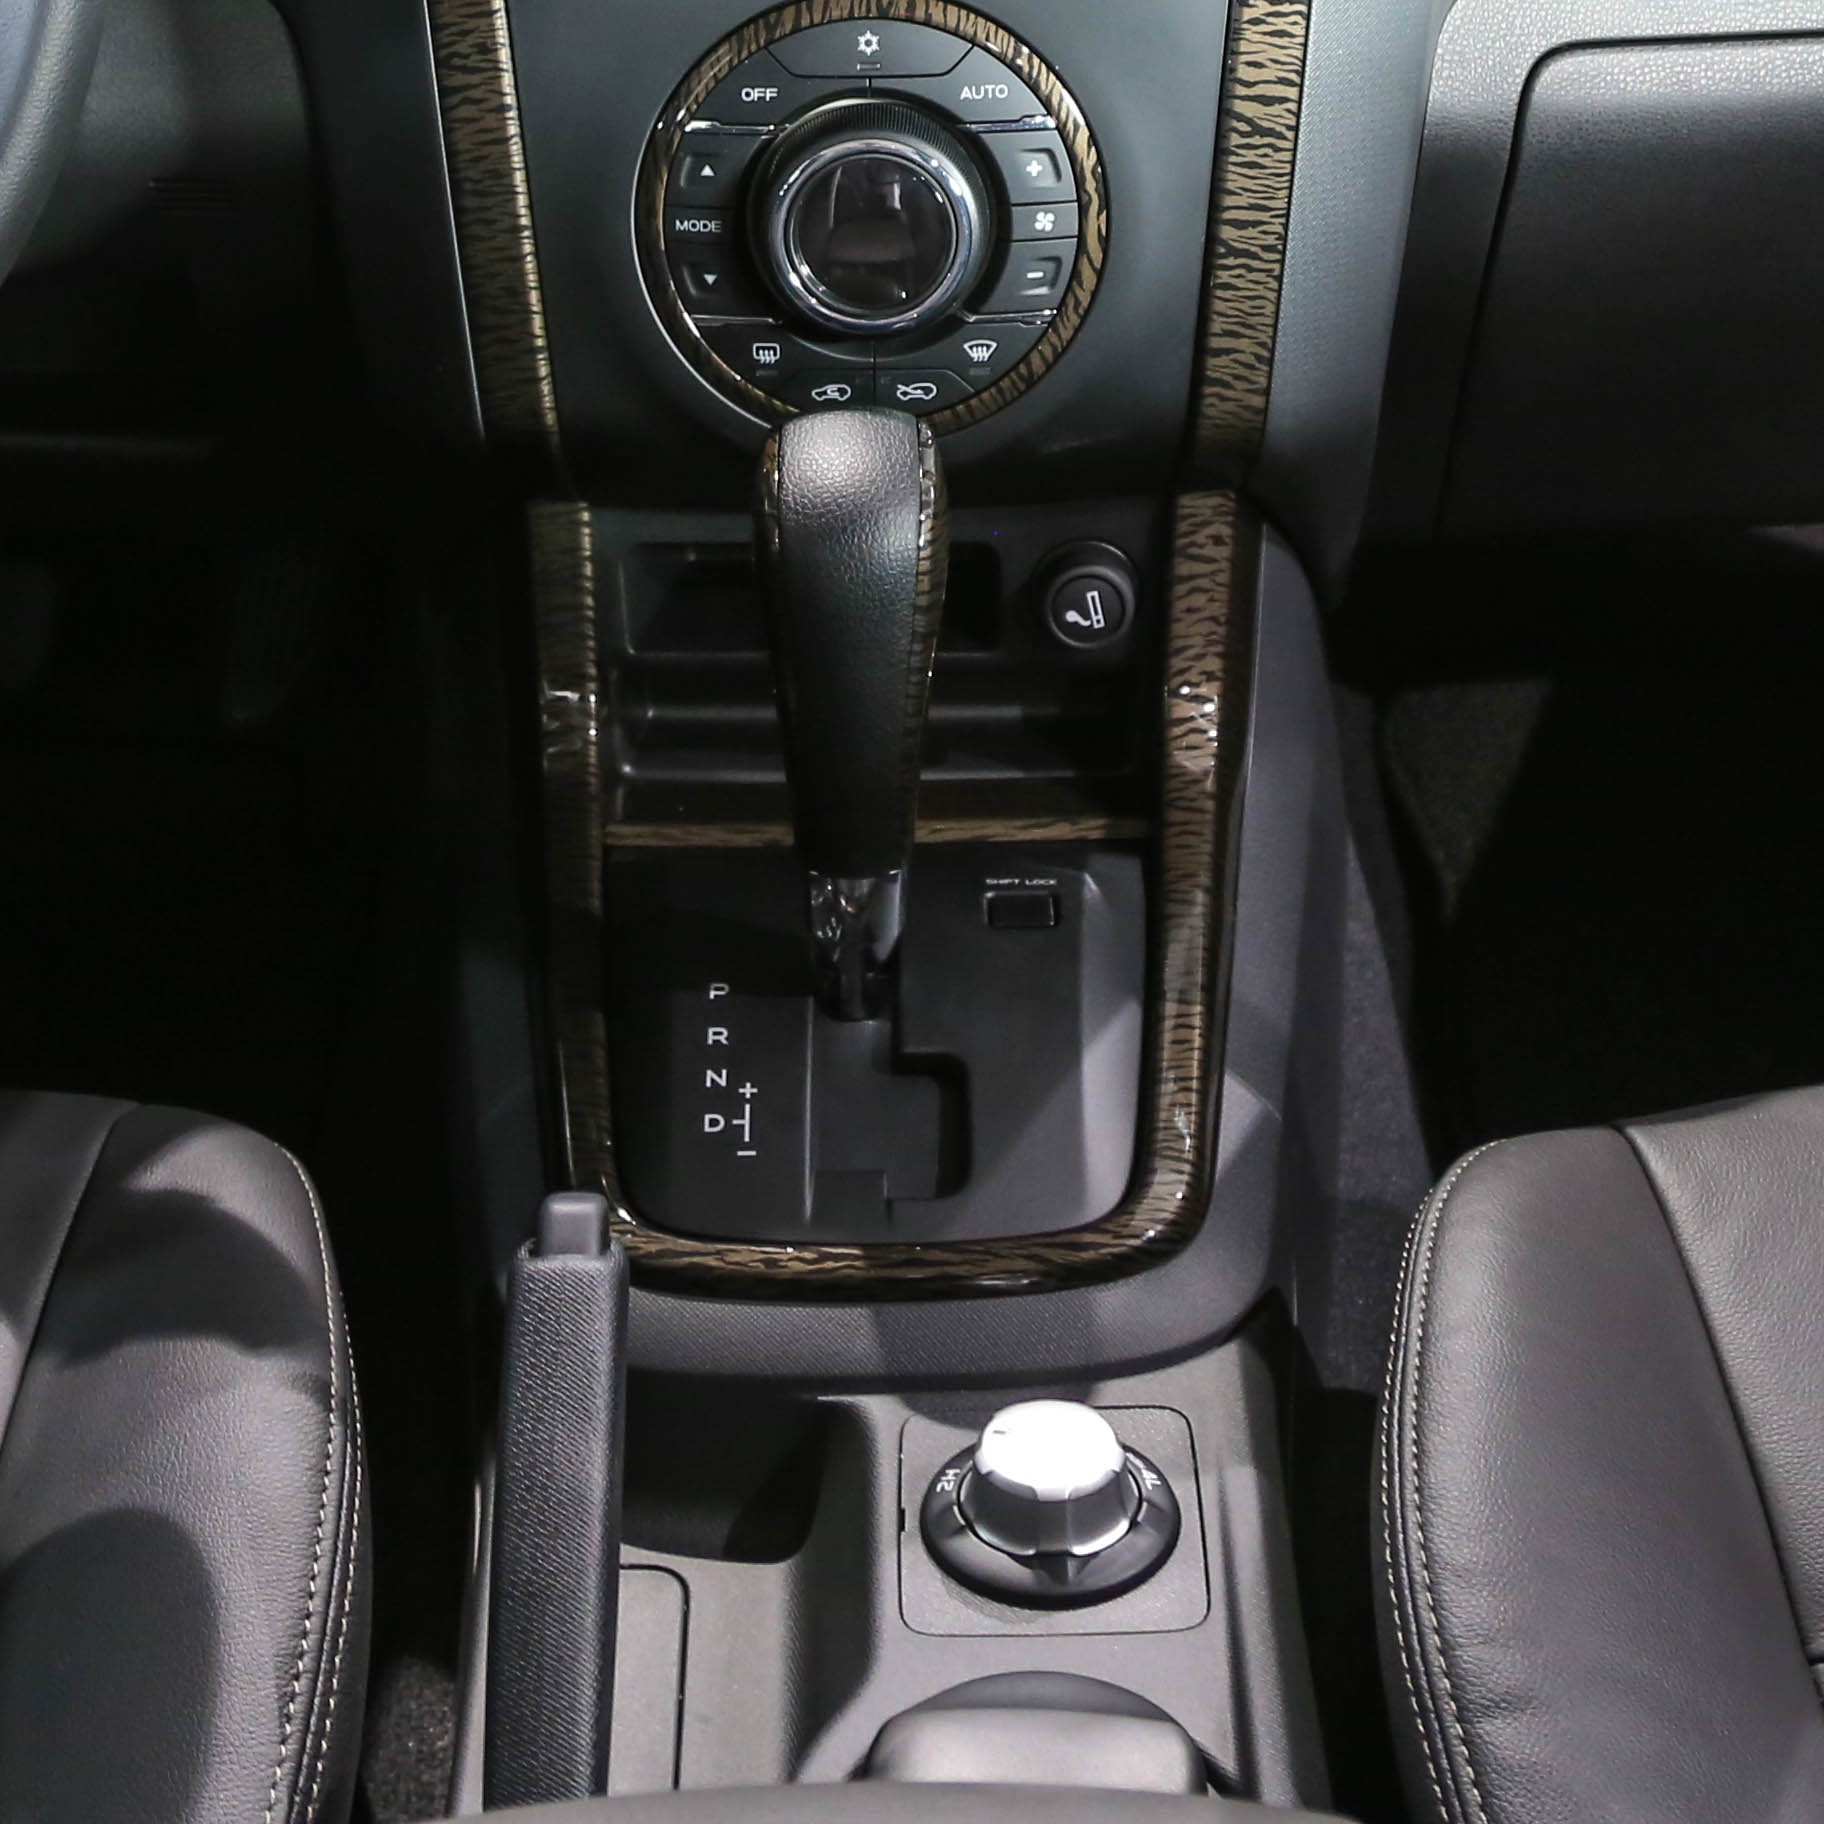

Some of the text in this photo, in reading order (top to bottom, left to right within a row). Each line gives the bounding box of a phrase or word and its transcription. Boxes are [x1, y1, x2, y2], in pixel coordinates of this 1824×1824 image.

[741, 86, 779, 104] OFF
[959, 83, 1009, 101] AUTO
[674, 217, 723, 235] MODE
[1026, 878, 1058, 887] LOCK
[709, 983, 730, 1000] P
[707, 1027, 728, 1045] R
[705, 1069, 727, 1088] N
[704, 1114, 726, 1133] D
